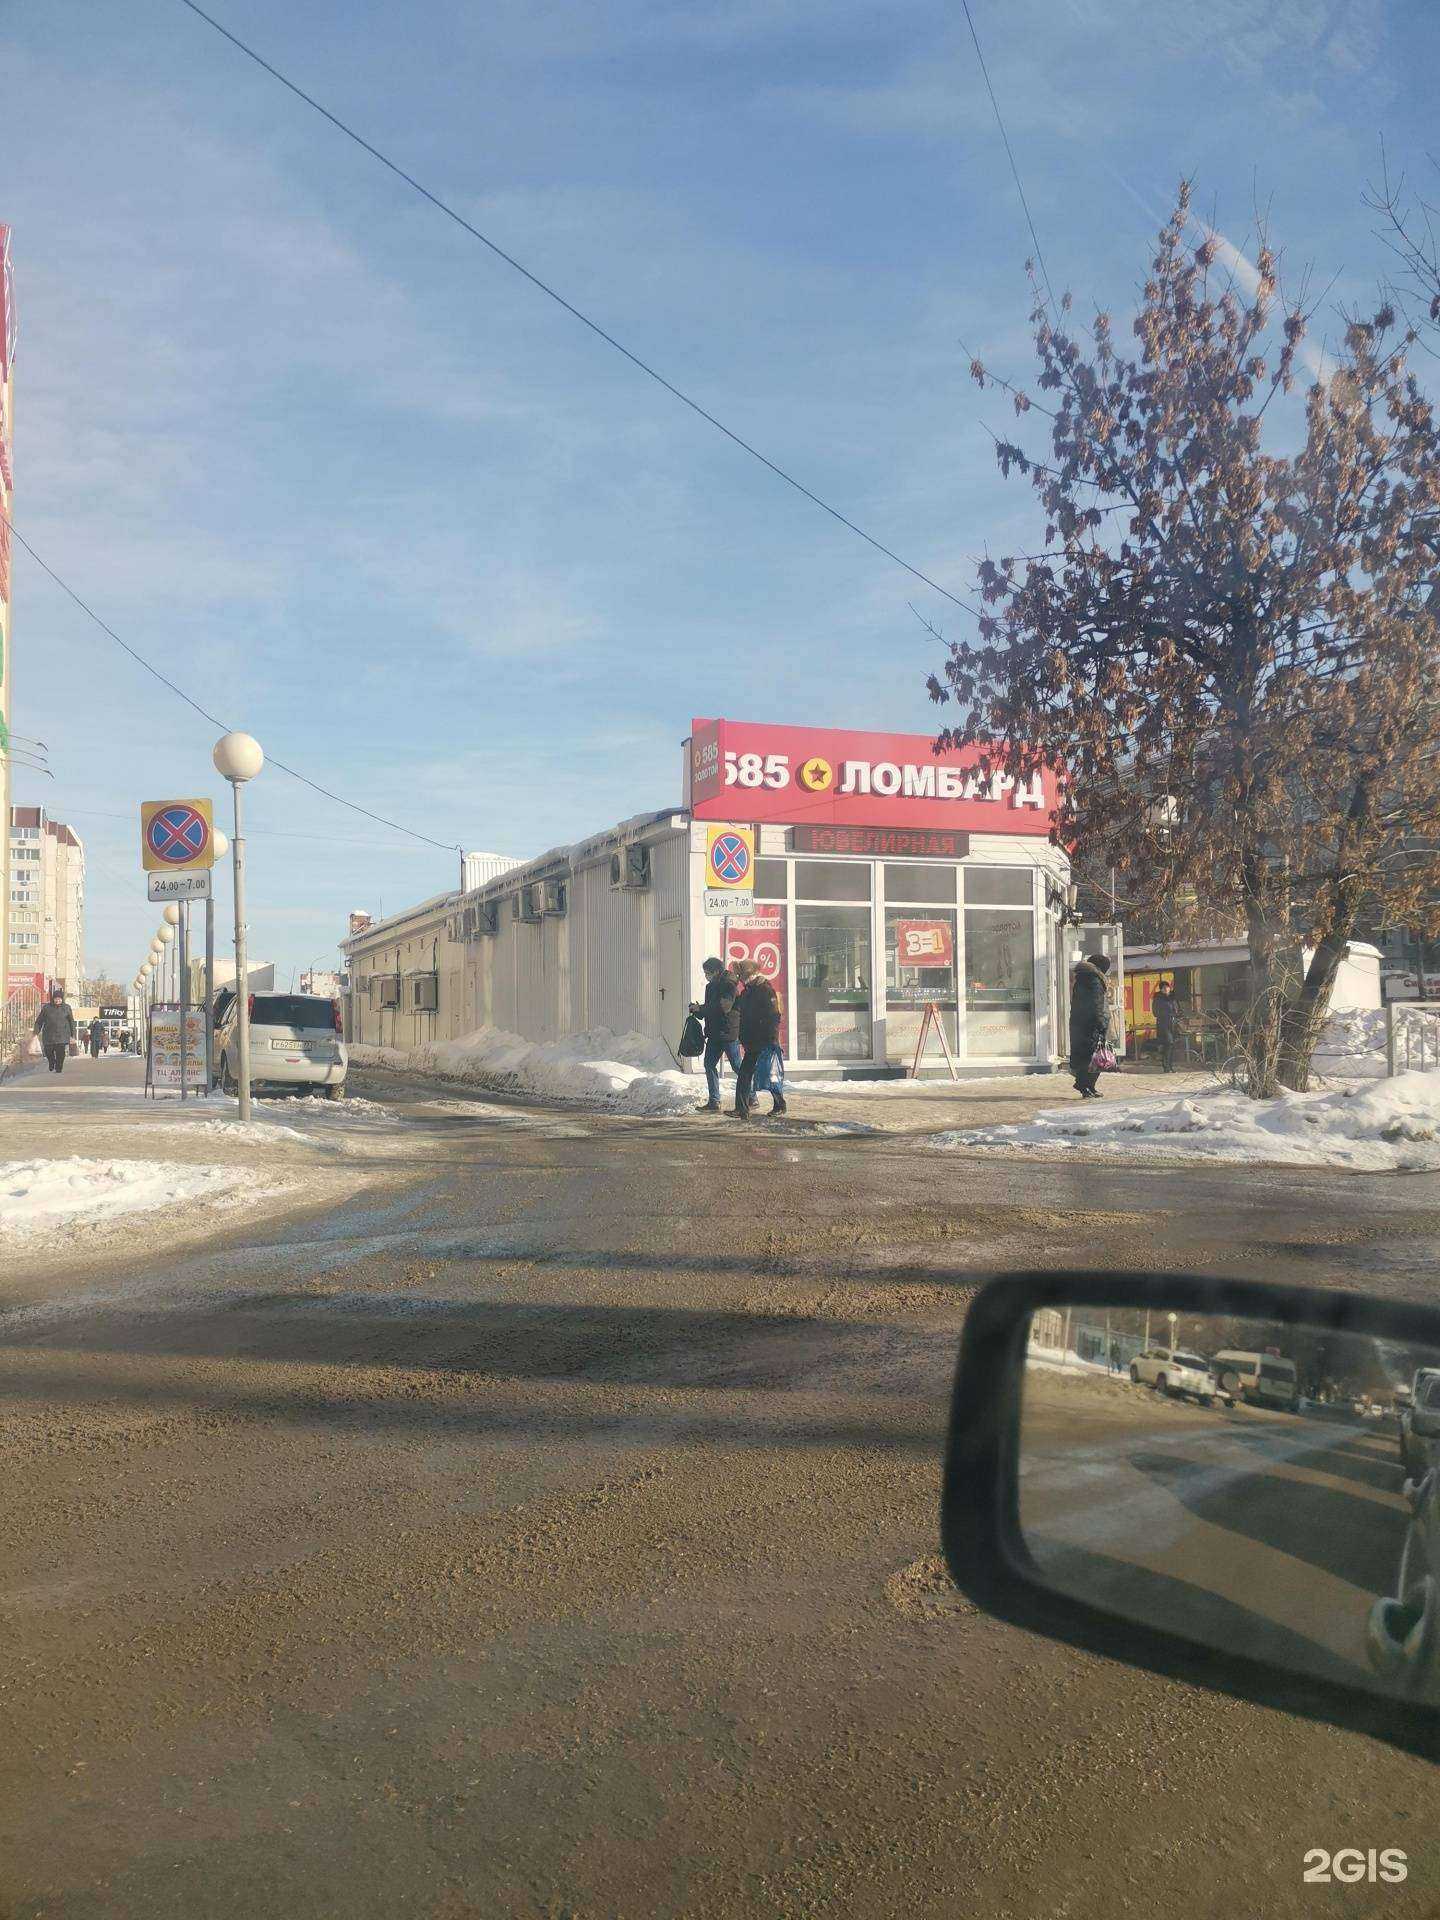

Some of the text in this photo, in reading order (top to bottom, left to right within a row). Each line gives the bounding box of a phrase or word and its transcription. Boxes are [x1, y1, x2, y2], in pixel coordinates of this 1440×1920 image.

[702, 741, 719, 764] 585
[724, 751, 1045, 809] 585 ЛОМБАРД
[810, 829, 956, 854] ЮВЕЛИРНАЯ
[154, 878, 206, 892] 24.00-7.00
[709, 897, 750, 908] 24.00-7.00
